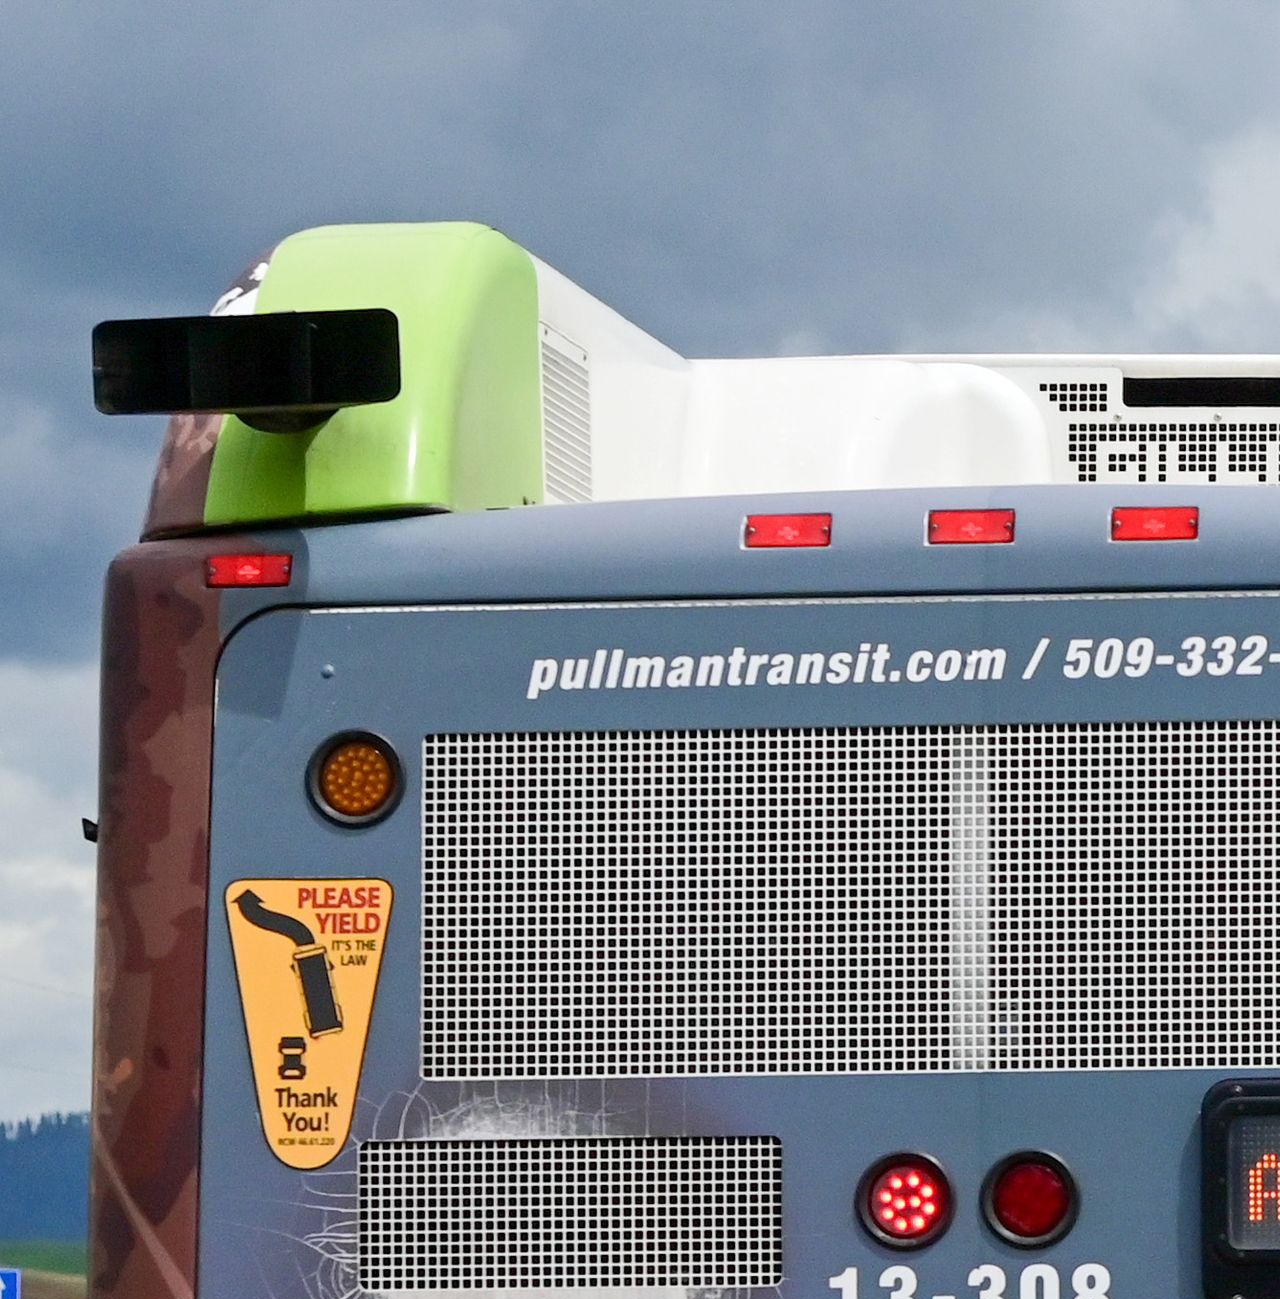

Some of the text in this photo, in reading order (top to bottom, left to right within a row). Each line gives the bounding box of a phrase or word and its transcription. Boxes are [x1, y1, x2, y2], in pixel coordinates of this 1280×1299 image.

[527, 643, 1007, 700] pullmantransit.com
[1022, 638, 1050, 680] /
[297, 887, 382, 909] PLEASE
[316, 912, 382, 934] YIELD
[331, 939, 377, 952] IT'S THE
[340, 954, 368, 967] LAW
[274, 1086, 338, 1108] Thank
[282, 1111, 331, 1132] You!
